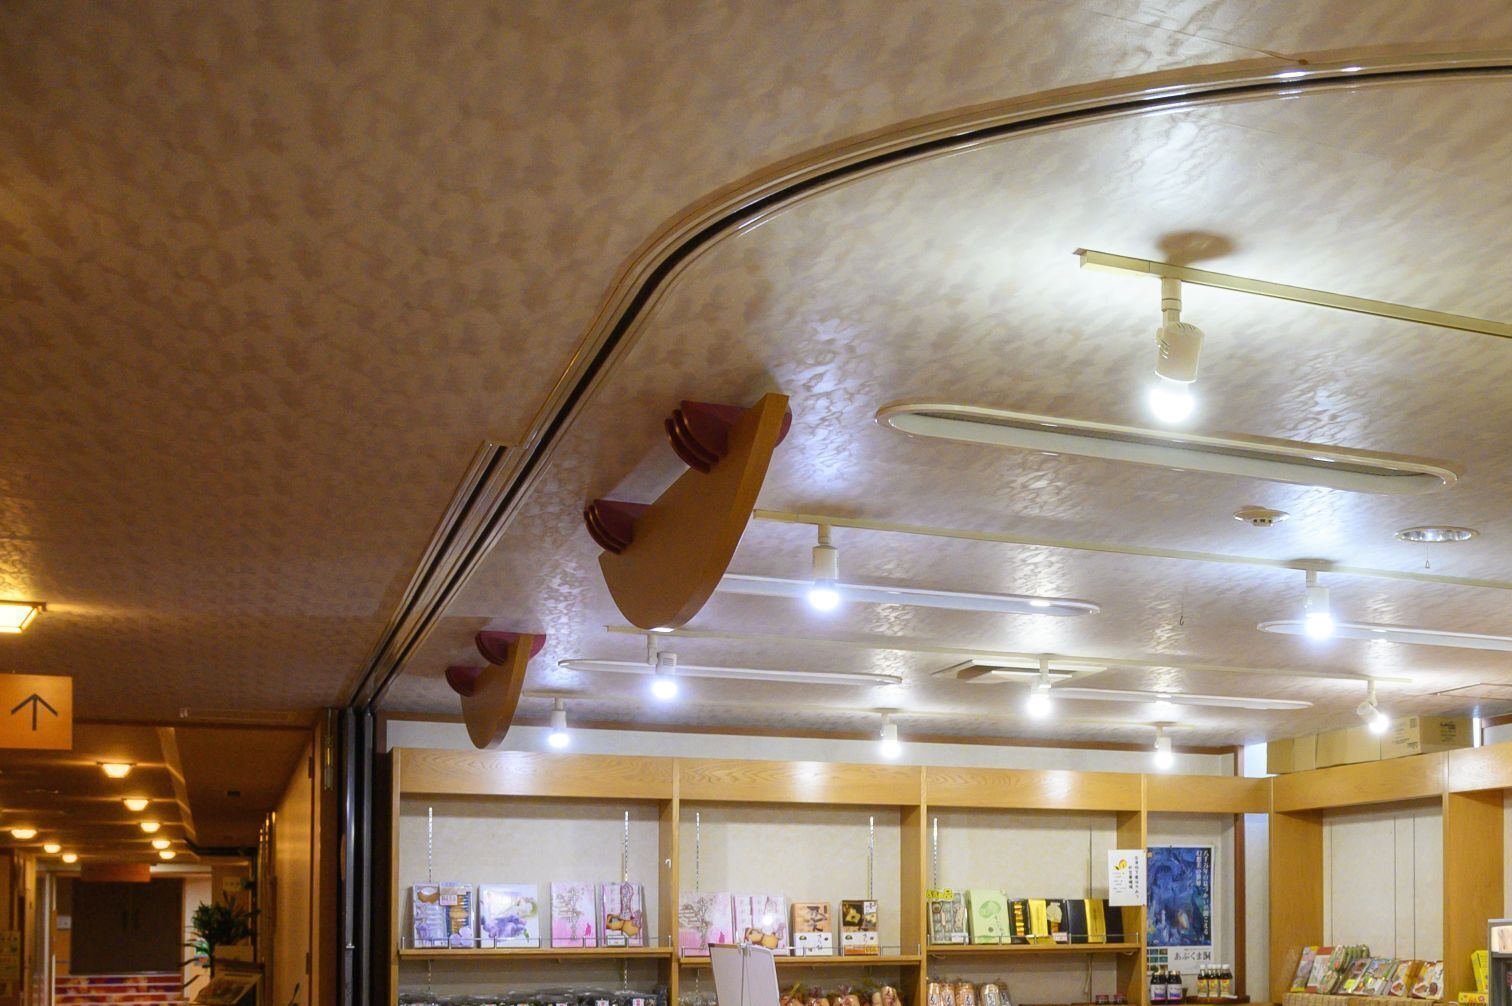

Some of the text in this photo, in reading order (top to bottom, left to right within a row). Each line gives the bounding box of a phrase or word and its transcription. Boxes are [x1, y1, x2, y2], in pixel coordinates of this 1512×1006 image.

[1174, 951, 1211, 961] あぶくま洞
